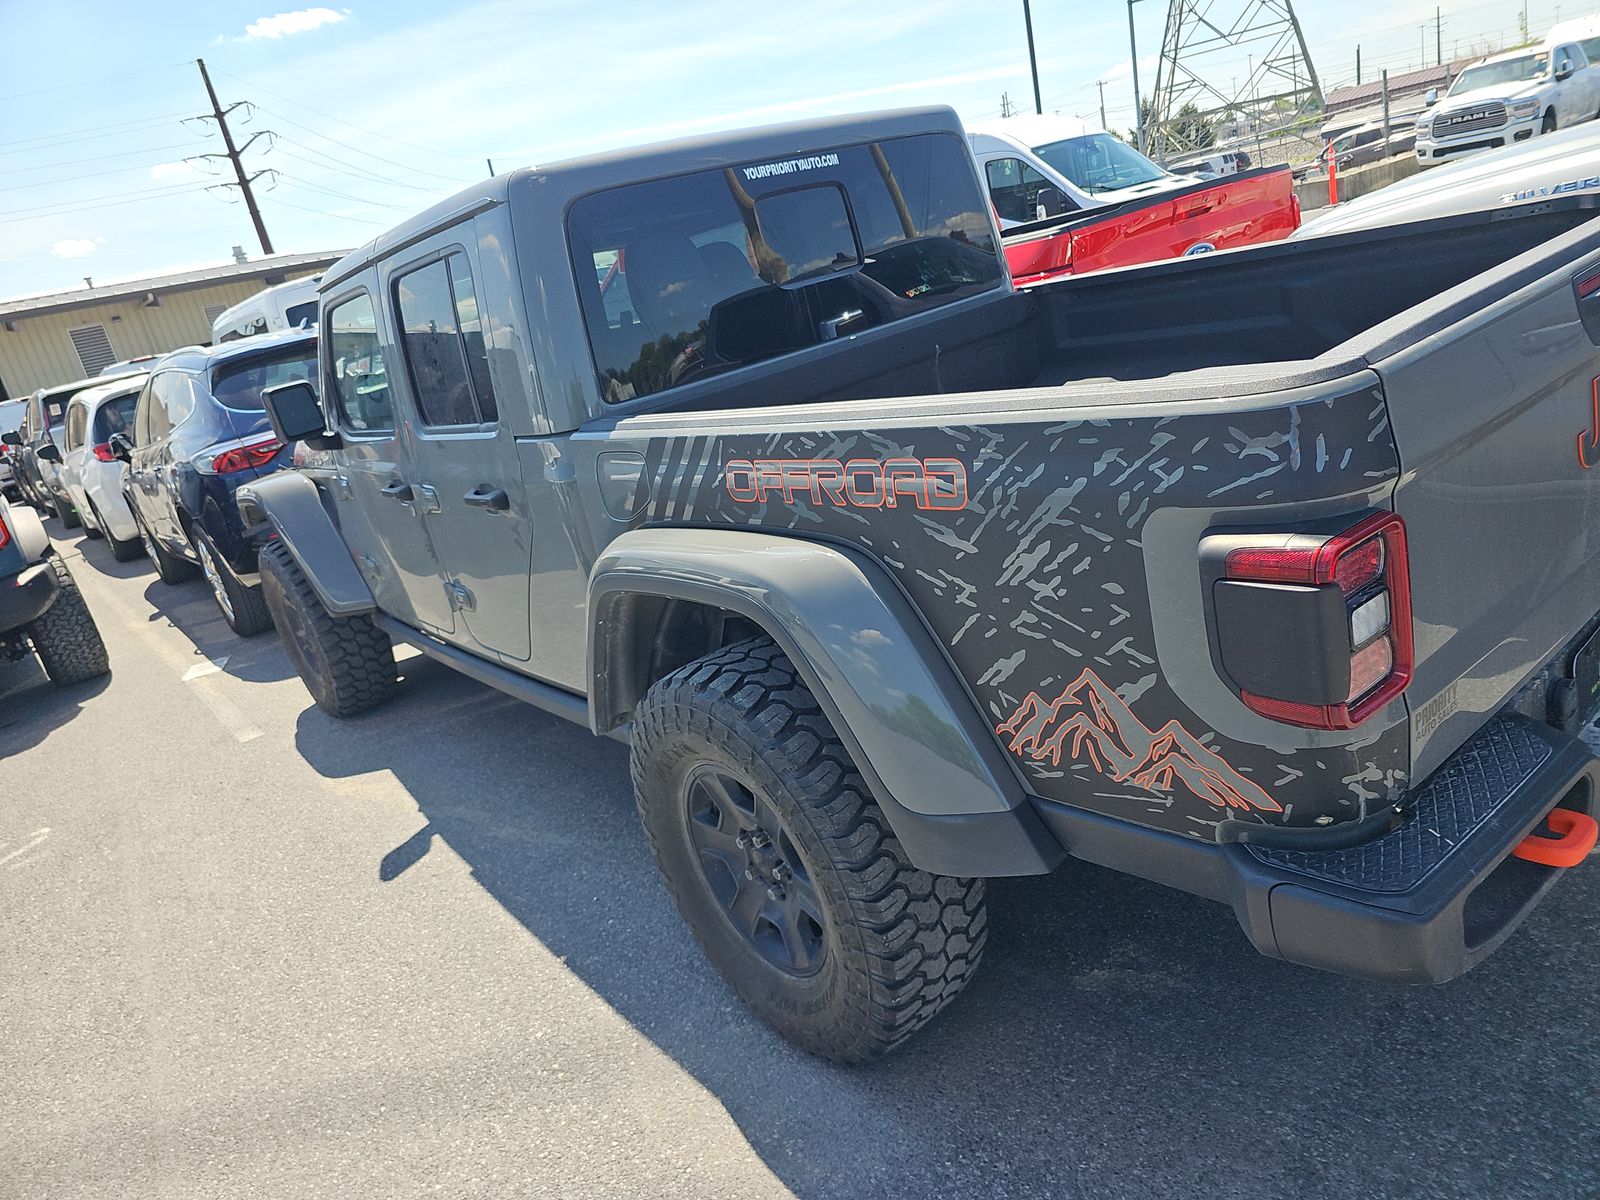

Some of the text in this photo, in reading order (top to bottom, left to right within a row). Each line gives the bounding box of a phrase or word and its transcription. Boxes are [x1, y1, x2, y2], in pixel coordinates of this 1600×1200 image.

[1452, 112, 1484, 124] RAM
[743, 153, 840, 181] YOURPRIORITYAUTO.COM
[726, 457, 968, 511] OFFROAD
[1415, 680, 1458, 731] PRIORITY
[1415, 717, 1437, 743] AUTO
